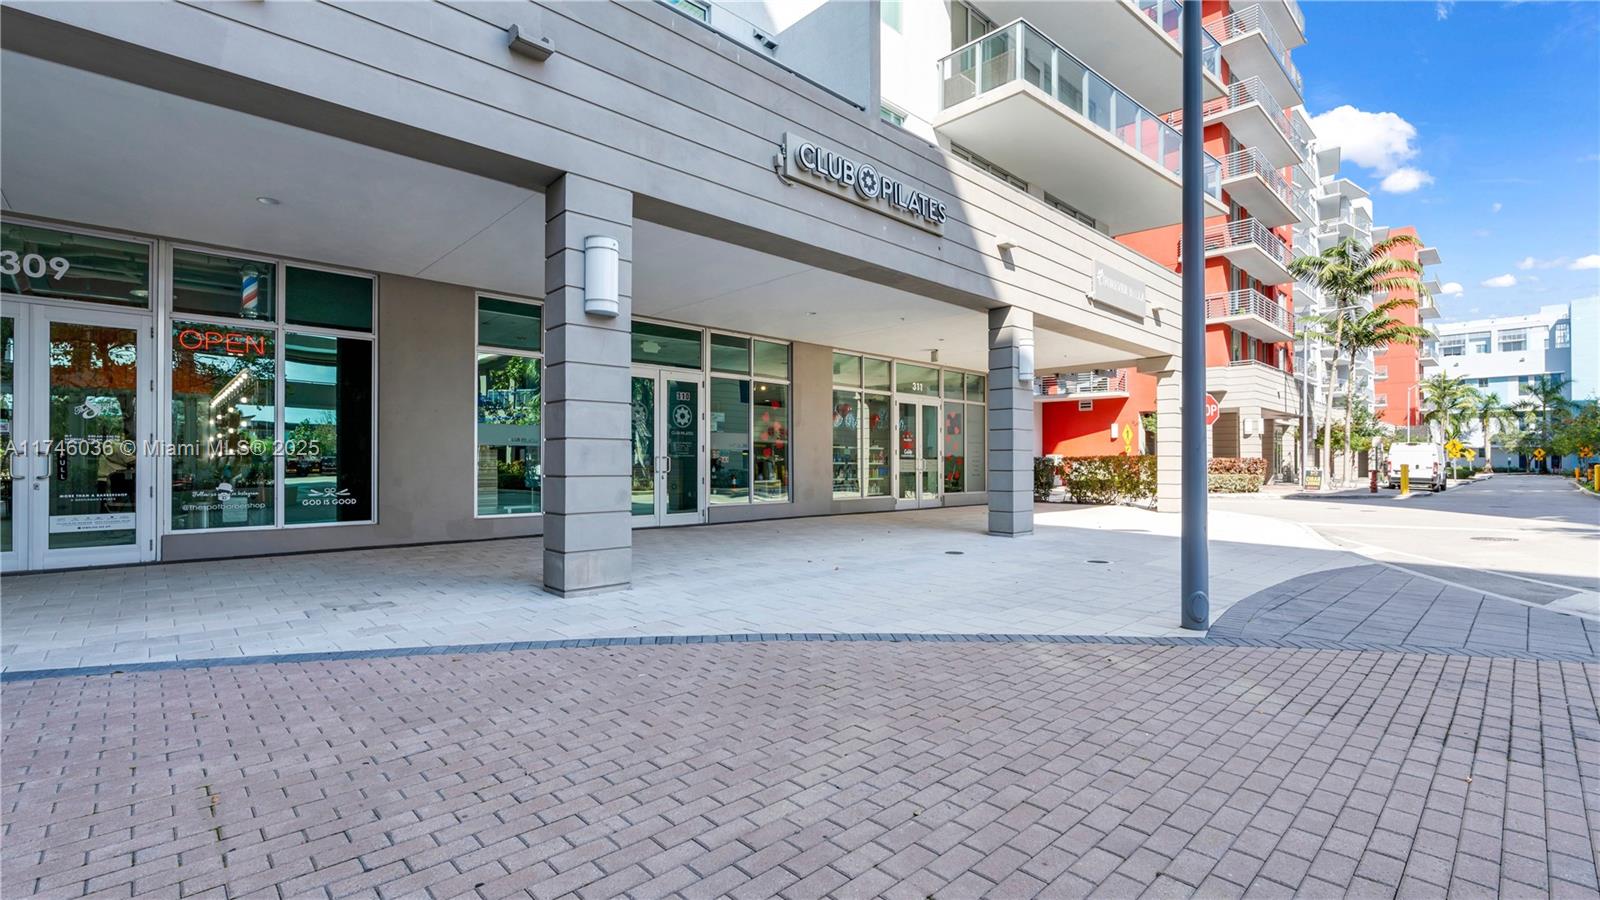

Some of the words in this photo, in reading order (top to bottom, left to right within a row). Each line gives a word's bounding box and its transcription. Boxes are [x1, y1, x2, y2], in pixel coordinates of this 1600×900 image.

[799, 142, 855, 186] CLUB
[880, 174, 948, 224] PILATES
[0, 250, 71, 281] 309
[179, 330, 265, 355] OPEN
